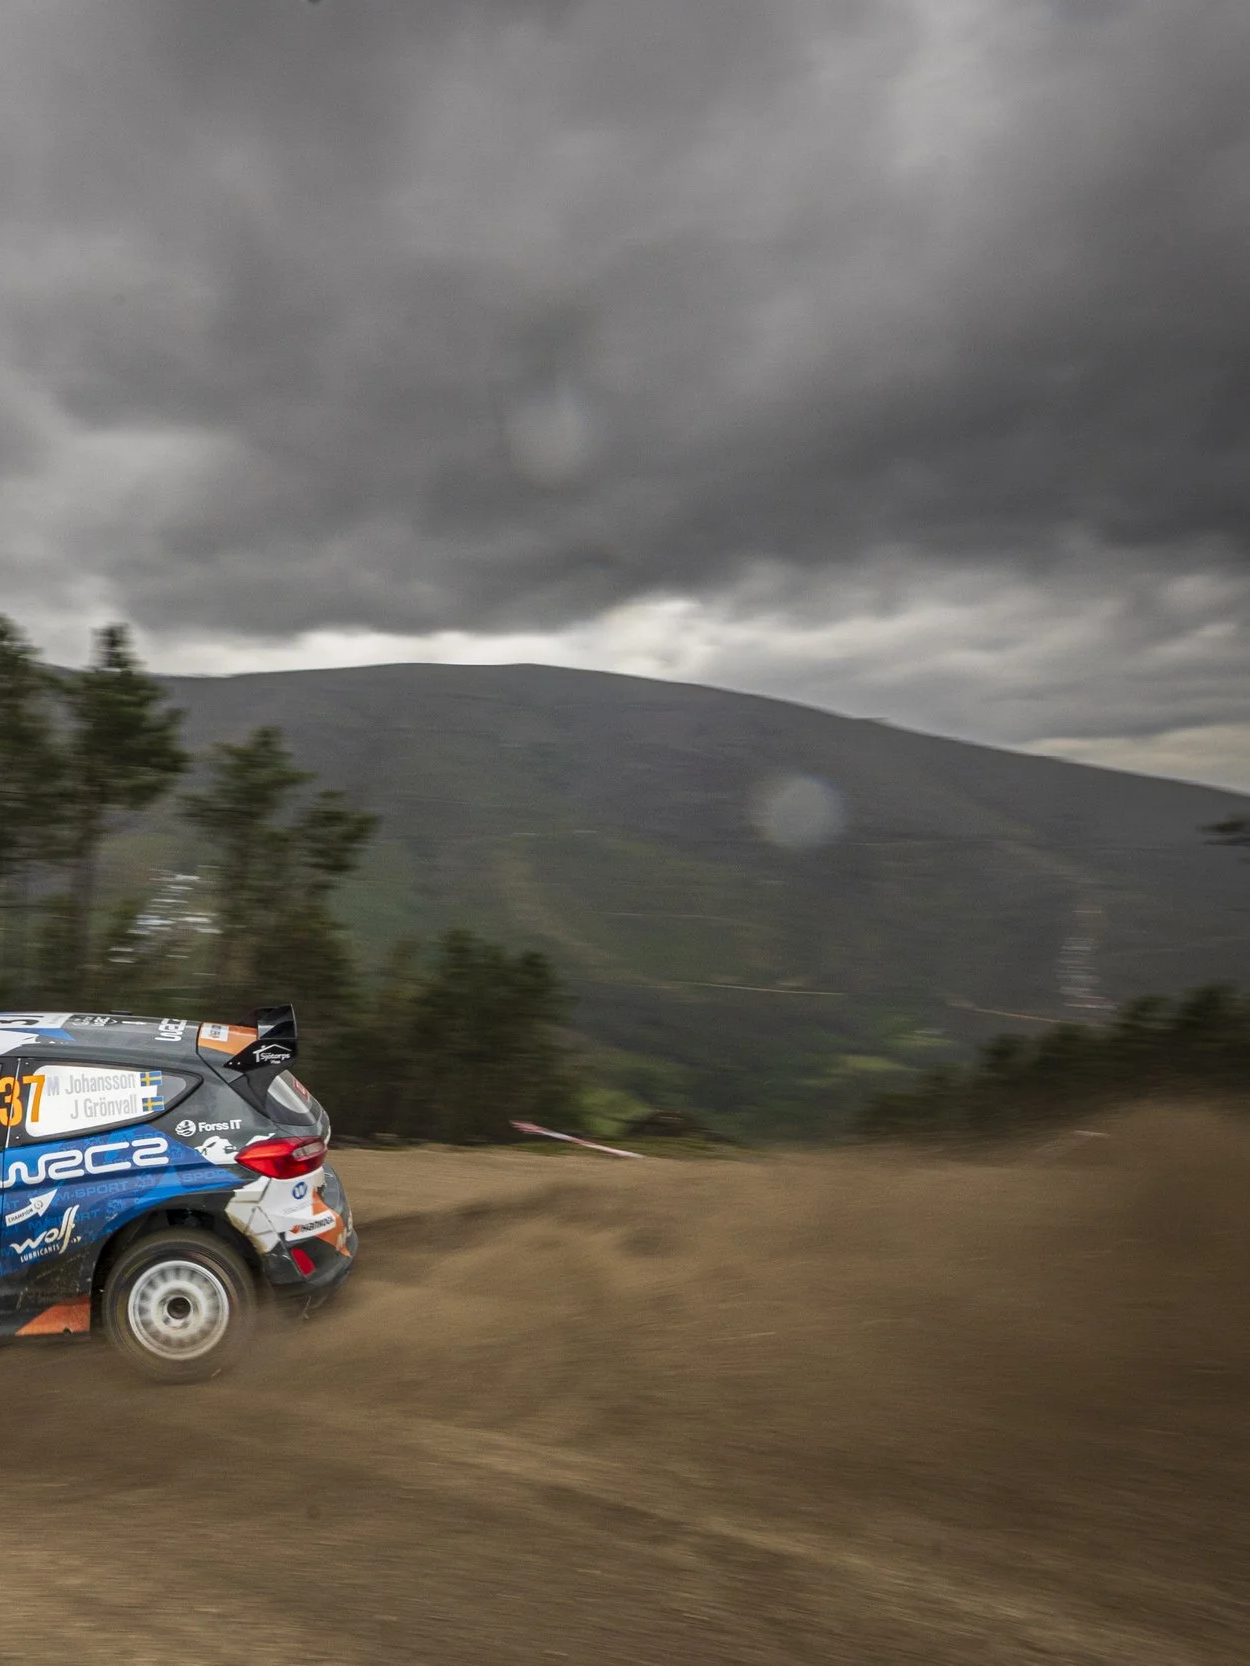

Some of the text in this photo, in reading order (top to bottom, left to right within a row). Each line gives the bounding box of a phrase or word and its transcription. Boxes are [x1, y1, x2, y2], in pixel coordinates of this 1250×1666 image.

[47, 1074, 136, 1097] M Johansson
[70, 1094, 138, 1120] J Grönvall
[198, 1119, 243, 1132] Forss IT
[7, 1208, 34, 1223] CHAMPION
[20, 1244, 60, 1263] LUBRICANTS
